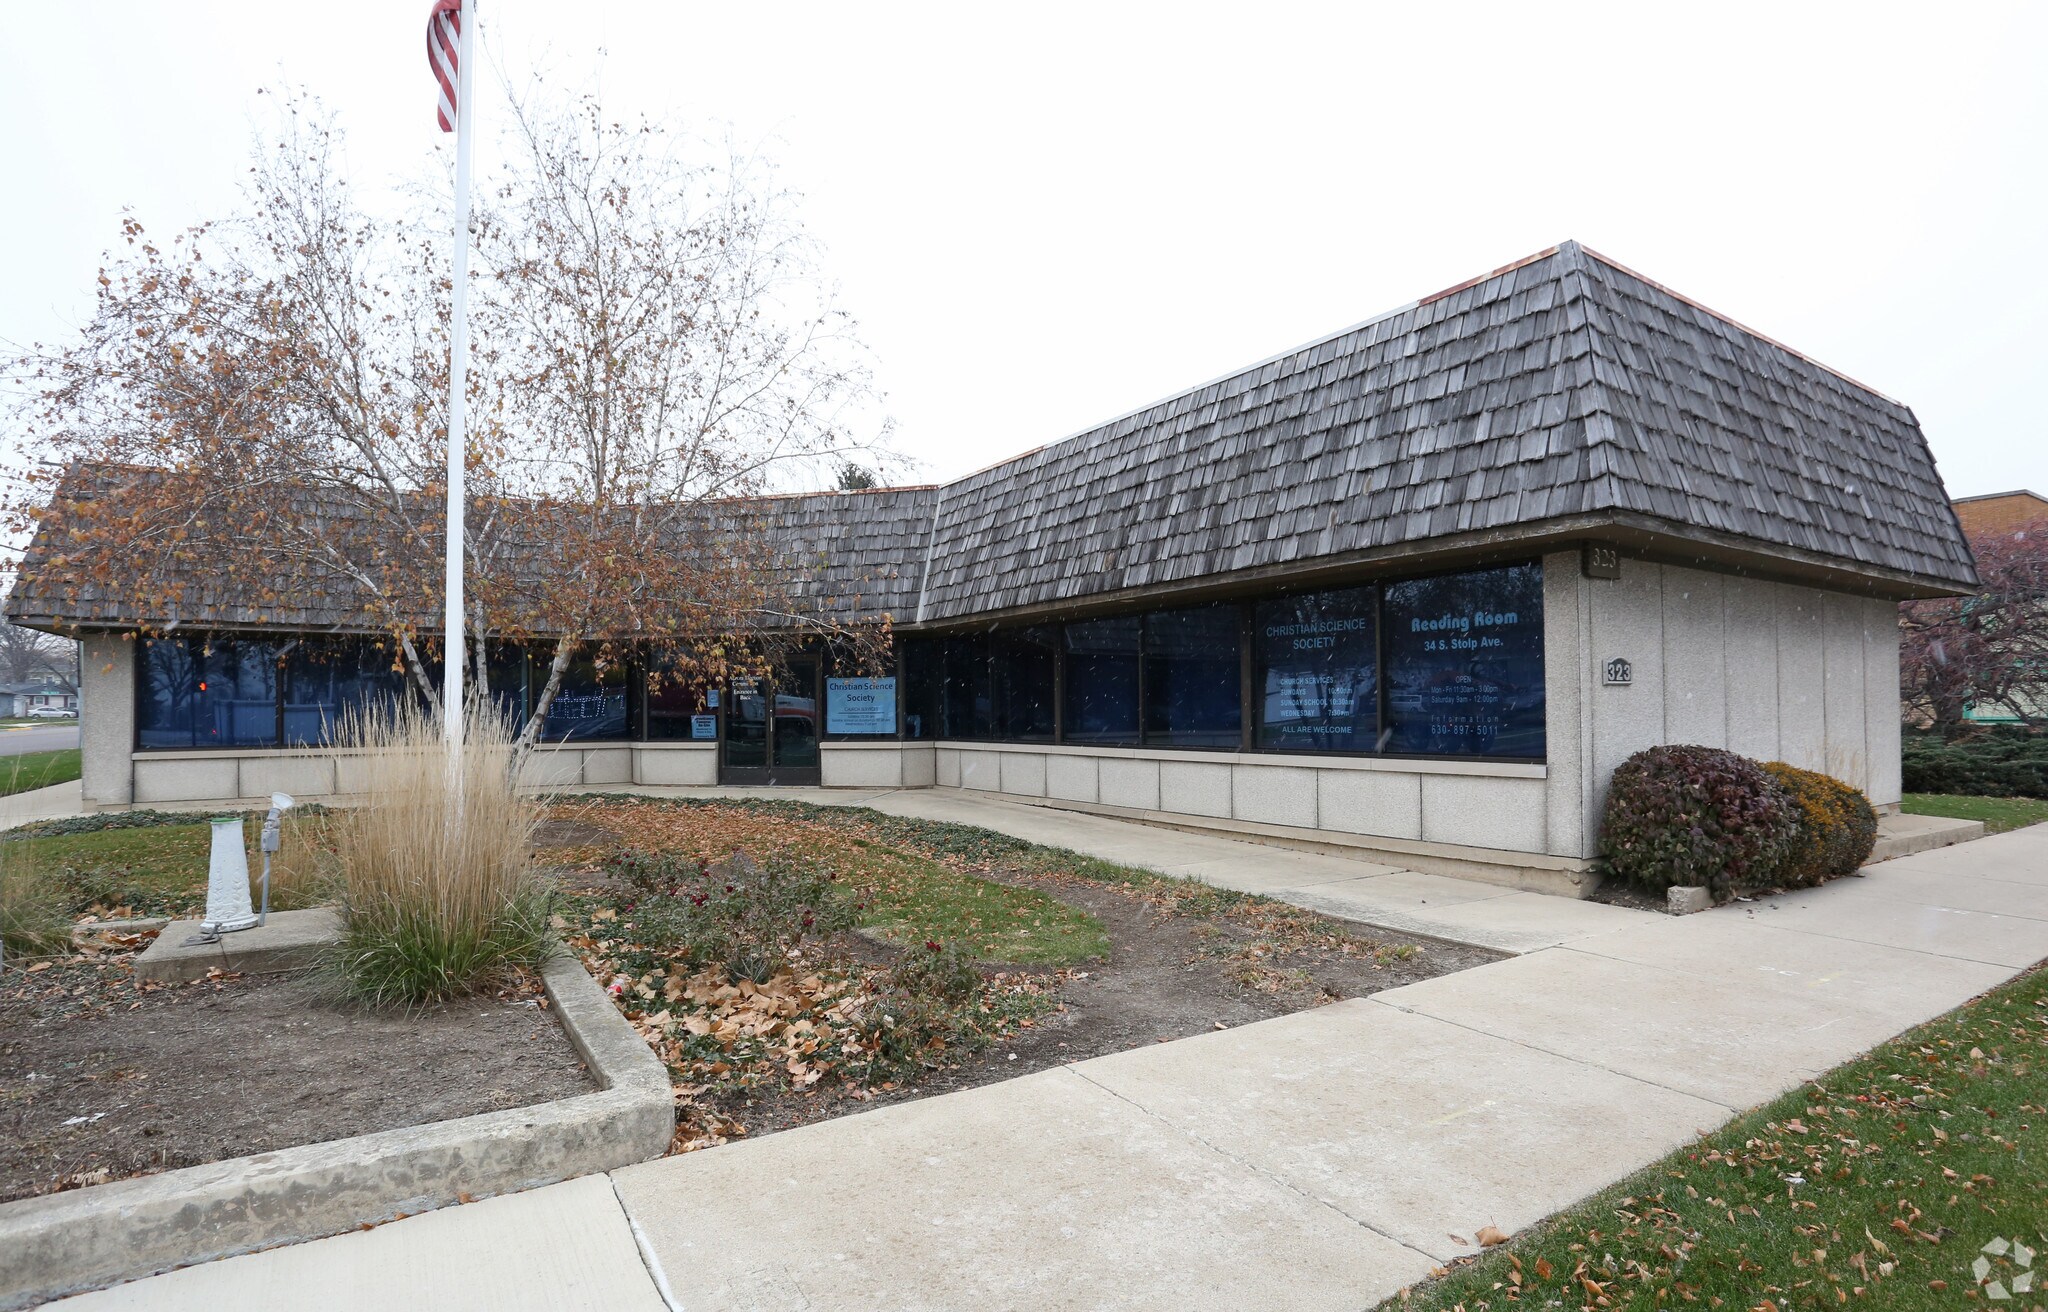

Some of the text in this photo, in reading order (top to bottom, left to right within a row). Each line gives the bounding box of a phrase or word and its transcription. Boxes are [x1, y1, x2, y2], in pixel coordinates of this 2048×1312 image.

[1593, 548, 1616, 568] 323
[1411, 611, 1518, 632] Reading Room
[1266, 618, 1366, 637] CHRISTIAN SCIENCE
[1293, 636, 1336, 650] SOCIETY
[1424, 636, 1504, 651] 34 S. Stolp Ave.
[1608, 664, 1631, 681] 323
[1280, 676, 1334, 685] CHURCH SERVICES
[1455, 675, 1472, 684] OPEN
[829, 682, 893, 691] Christian Science
[1280, 688, 1307, 696] SUNDAYS
[847, 694, 876, 704] Society
[1304, 698, 1328, 706] SCHOOL
[1431, 695, 1455, 704] Saturday
[1280, 709, 1315, 717] WEDNESDAY
[1313, 726, 1352, 734] WELCOME
